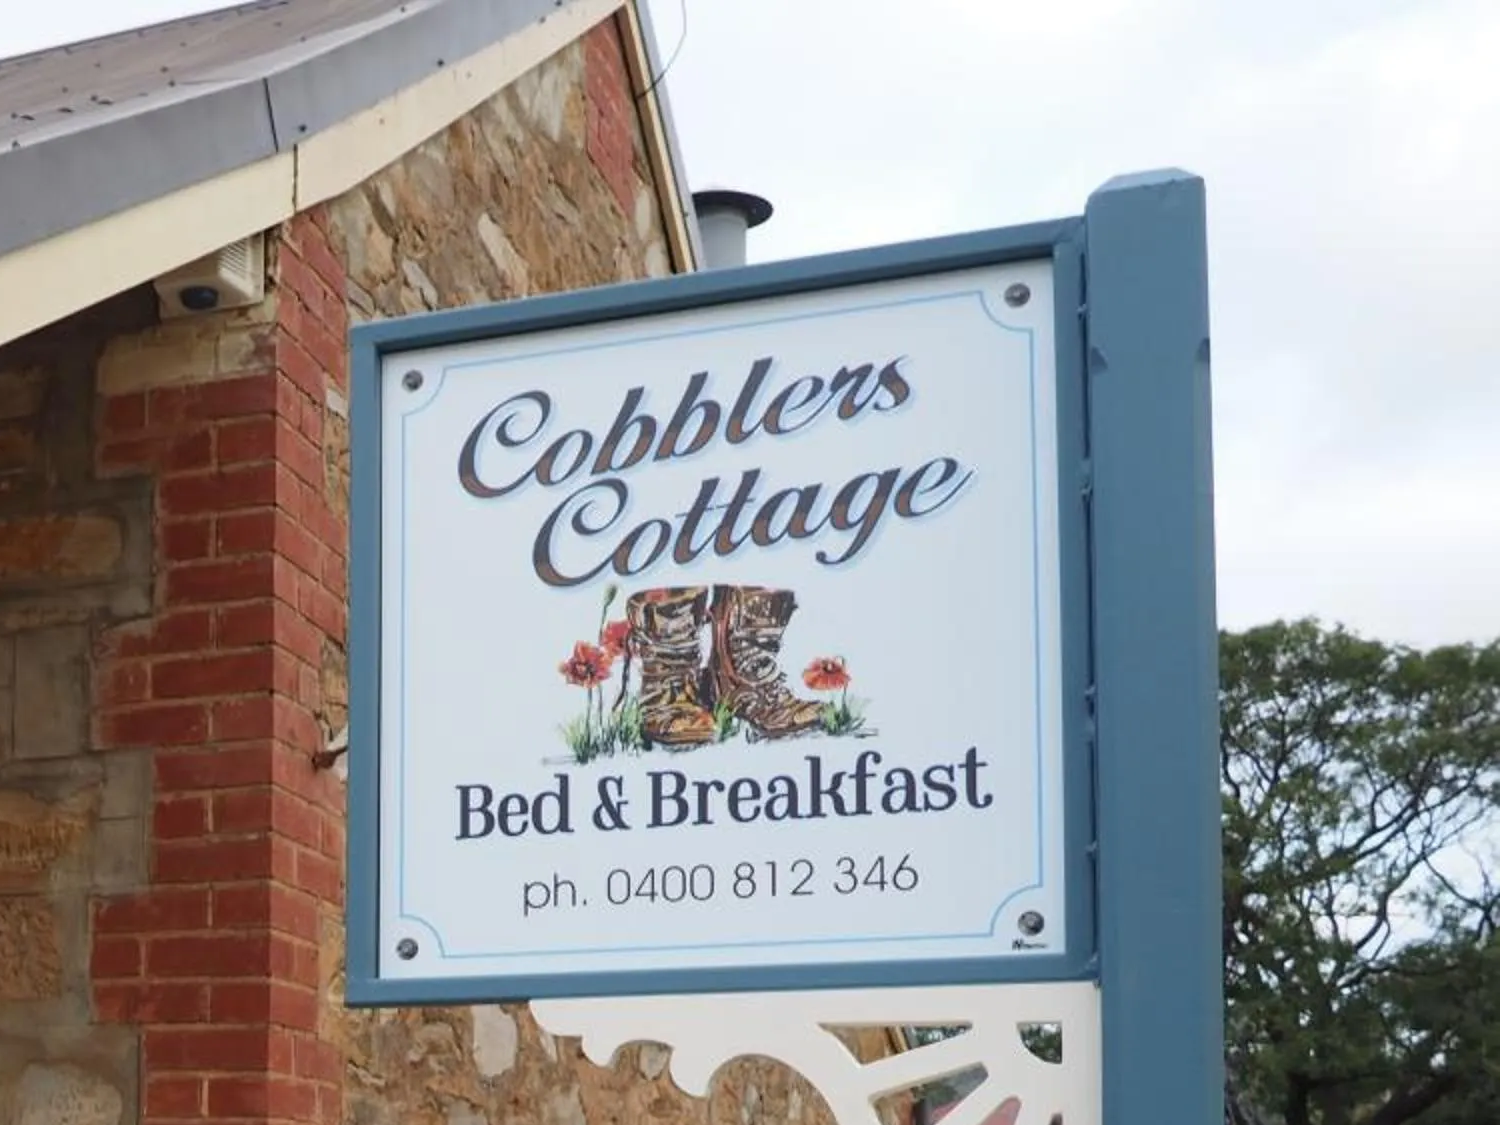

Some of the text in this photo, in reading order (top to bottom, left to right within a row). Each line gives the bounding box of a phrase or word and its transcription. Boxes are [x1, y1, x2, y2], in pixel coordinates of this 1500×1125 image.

[458, 355, 911, 499] Cobblers
[532, 457, 974, 587] Cottage
[454, 746, 994, 841] Bed & Breakfast
[522, 853, 920, 917] ph. 0400 812 346
